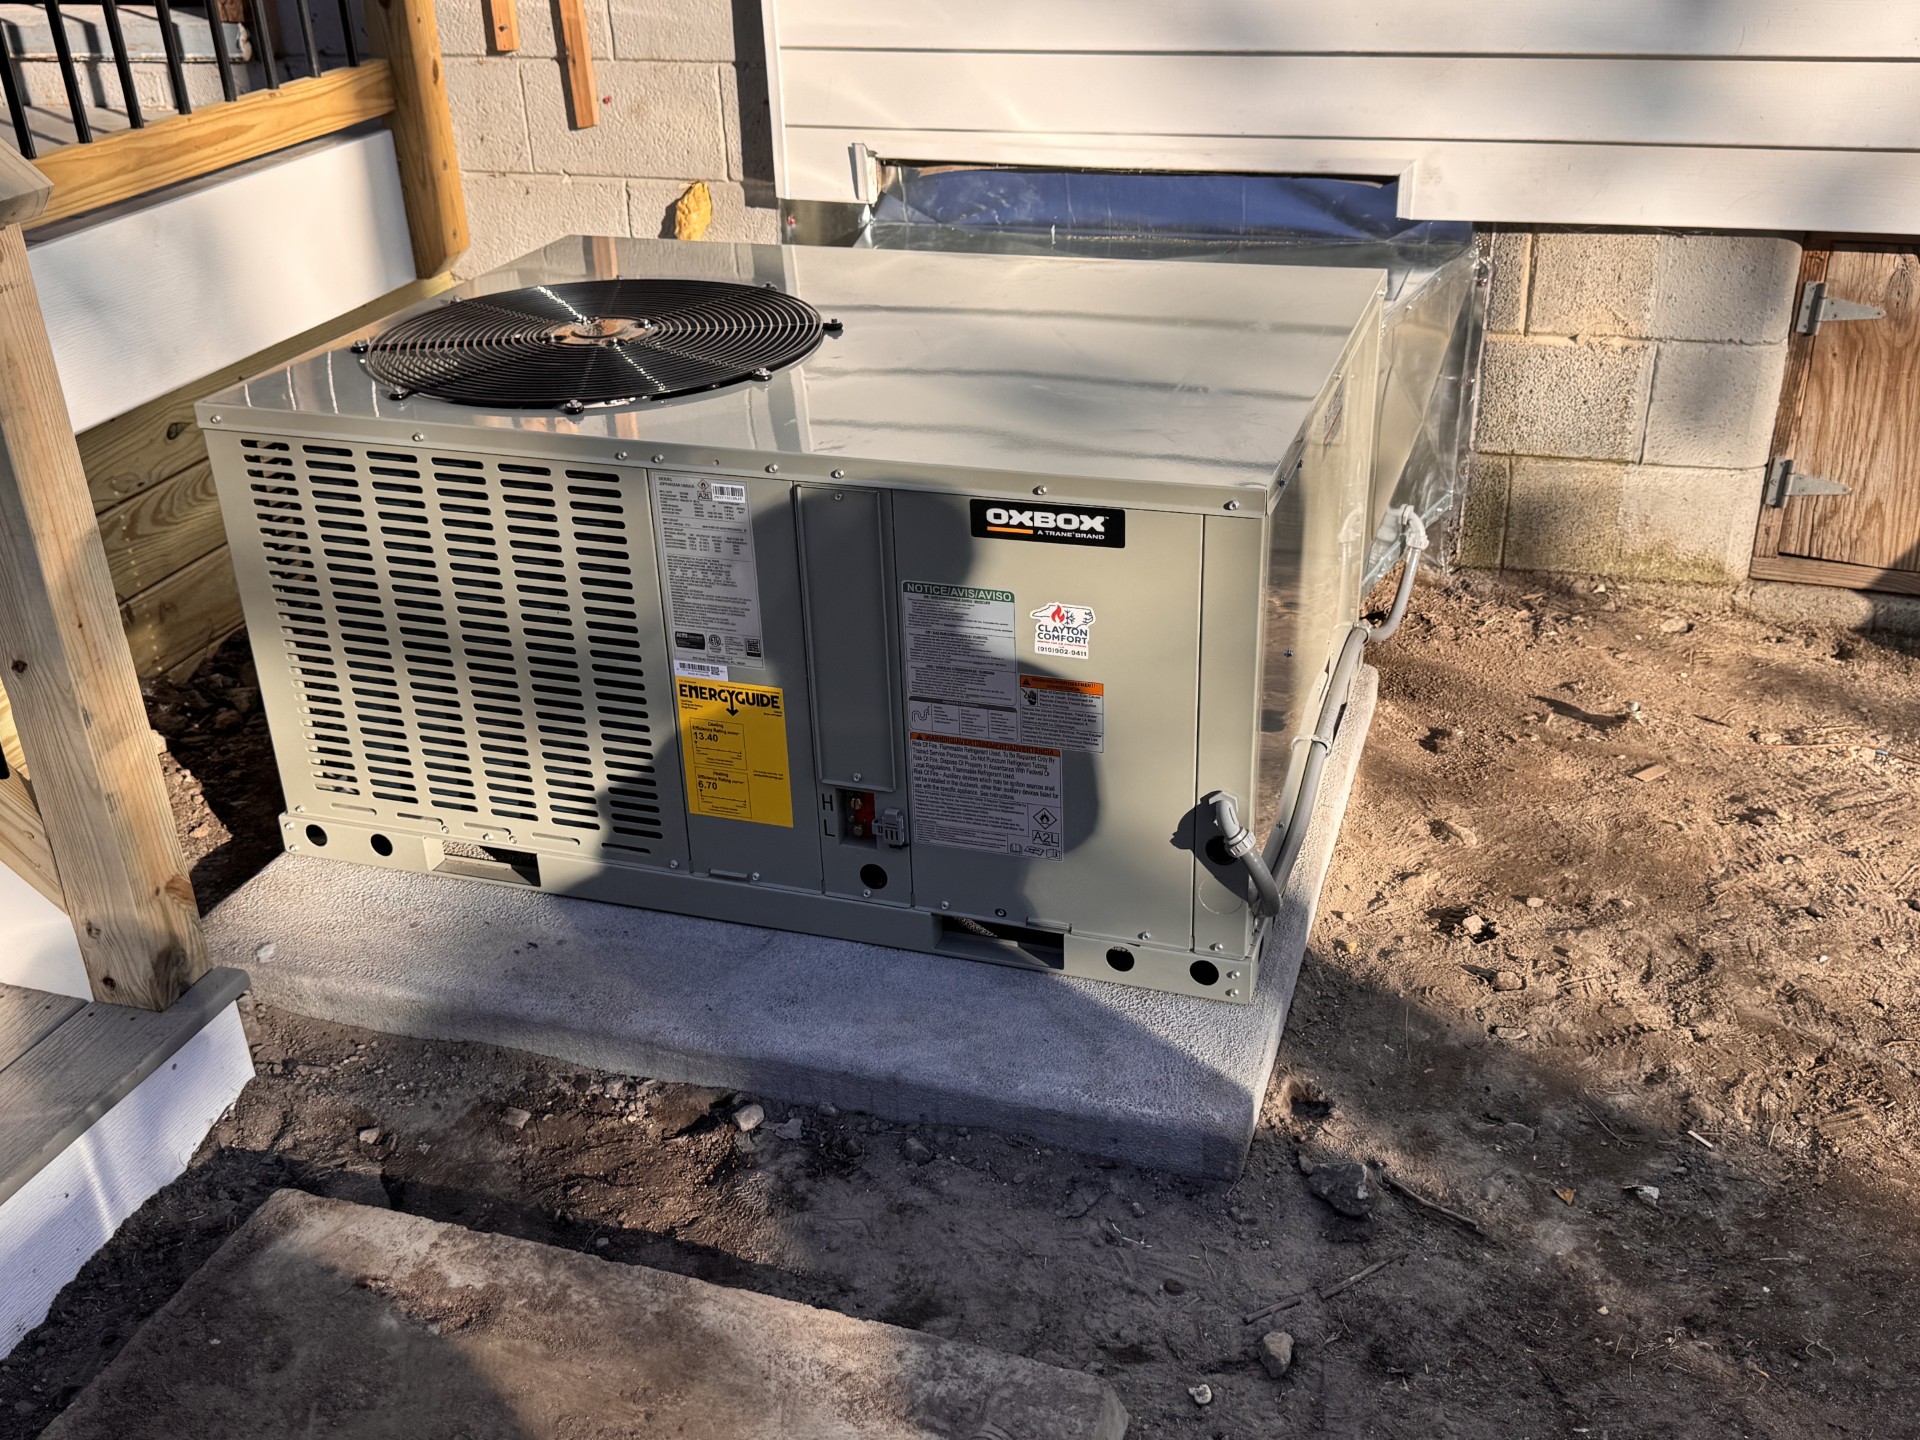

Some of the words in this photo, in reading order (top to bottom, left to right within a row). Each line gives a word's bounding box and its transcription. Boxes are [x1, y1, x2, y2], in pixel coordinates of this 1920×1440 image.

[1075, 532, 1105, 540] BRAND
[906, 583, 1012, 601] NOTICE/AVIS/AVISO
[1037, 624, 1088, 637] CLAYTON
[1037, 632, 1088, 645] COMFORT
[679, 684, 780, 710] ENERGYGUIDE
[693, 732, 718, 742] 13.40
[698, 780, 718, 790] 6.70
[822, 793, 833, 811] H
[824, 819, 835, 837] L
[1033, 831, 1059, 844] A2L
